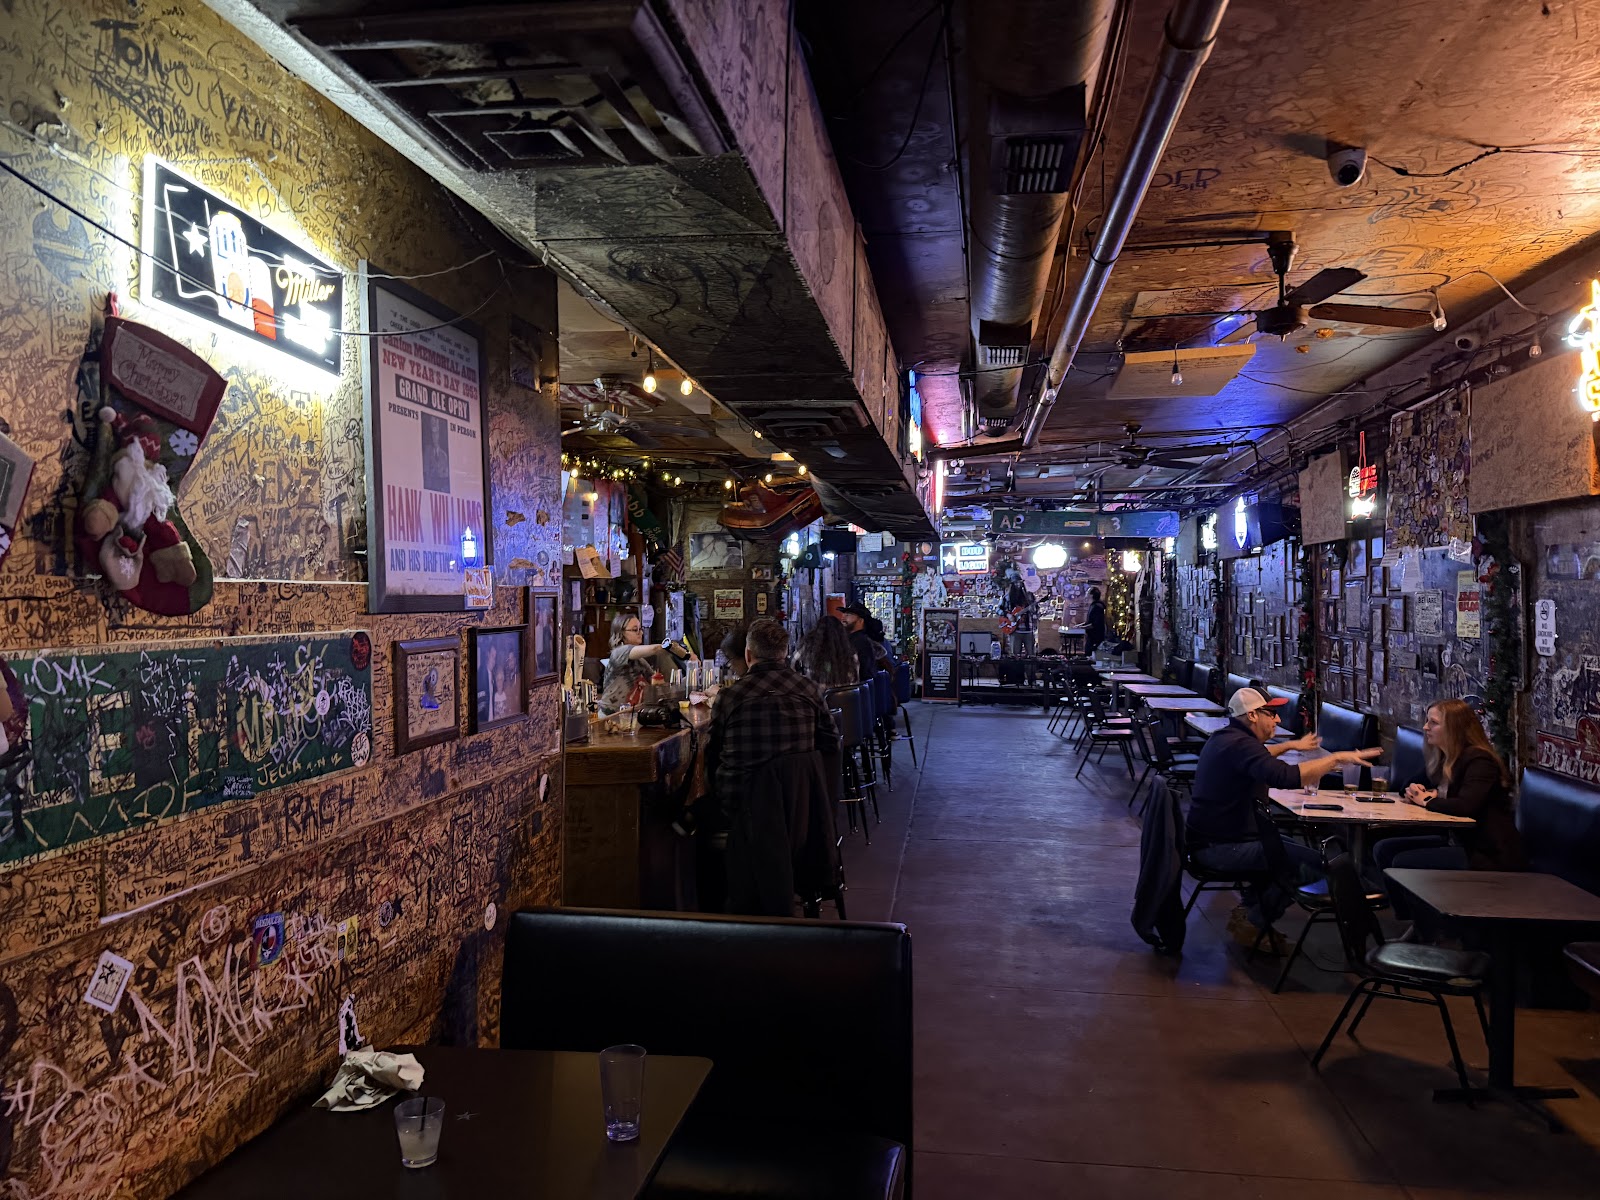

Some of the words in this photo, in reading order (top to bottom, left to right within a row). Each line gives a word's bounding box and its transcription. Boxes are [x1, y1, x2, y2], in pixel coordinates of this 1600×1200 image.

[275, 265, 335, 306] Miller
[382, 348, 406, 372] NEW
[409, 359, 442, 387] YEAR'S
[444, 374, 460, 393] DAY
[413, 342, 461, 376] MEMORIAL
[388, 402, 419, 421] PRESENTS
[400, 378, 428, 405] GRAND
[432, 390, 447, 412] OLE
[449, 396, 468, 419] OPRY
[449, 422, 456, 432] IN
[457, 425, 477, 439] PERSON
[387, 484, 425, 544] HANK
[430, 492, 485, 548] WILLIAMS
[390, 547, 406, 571] AND
[408, 549, 421, 572] HIS
